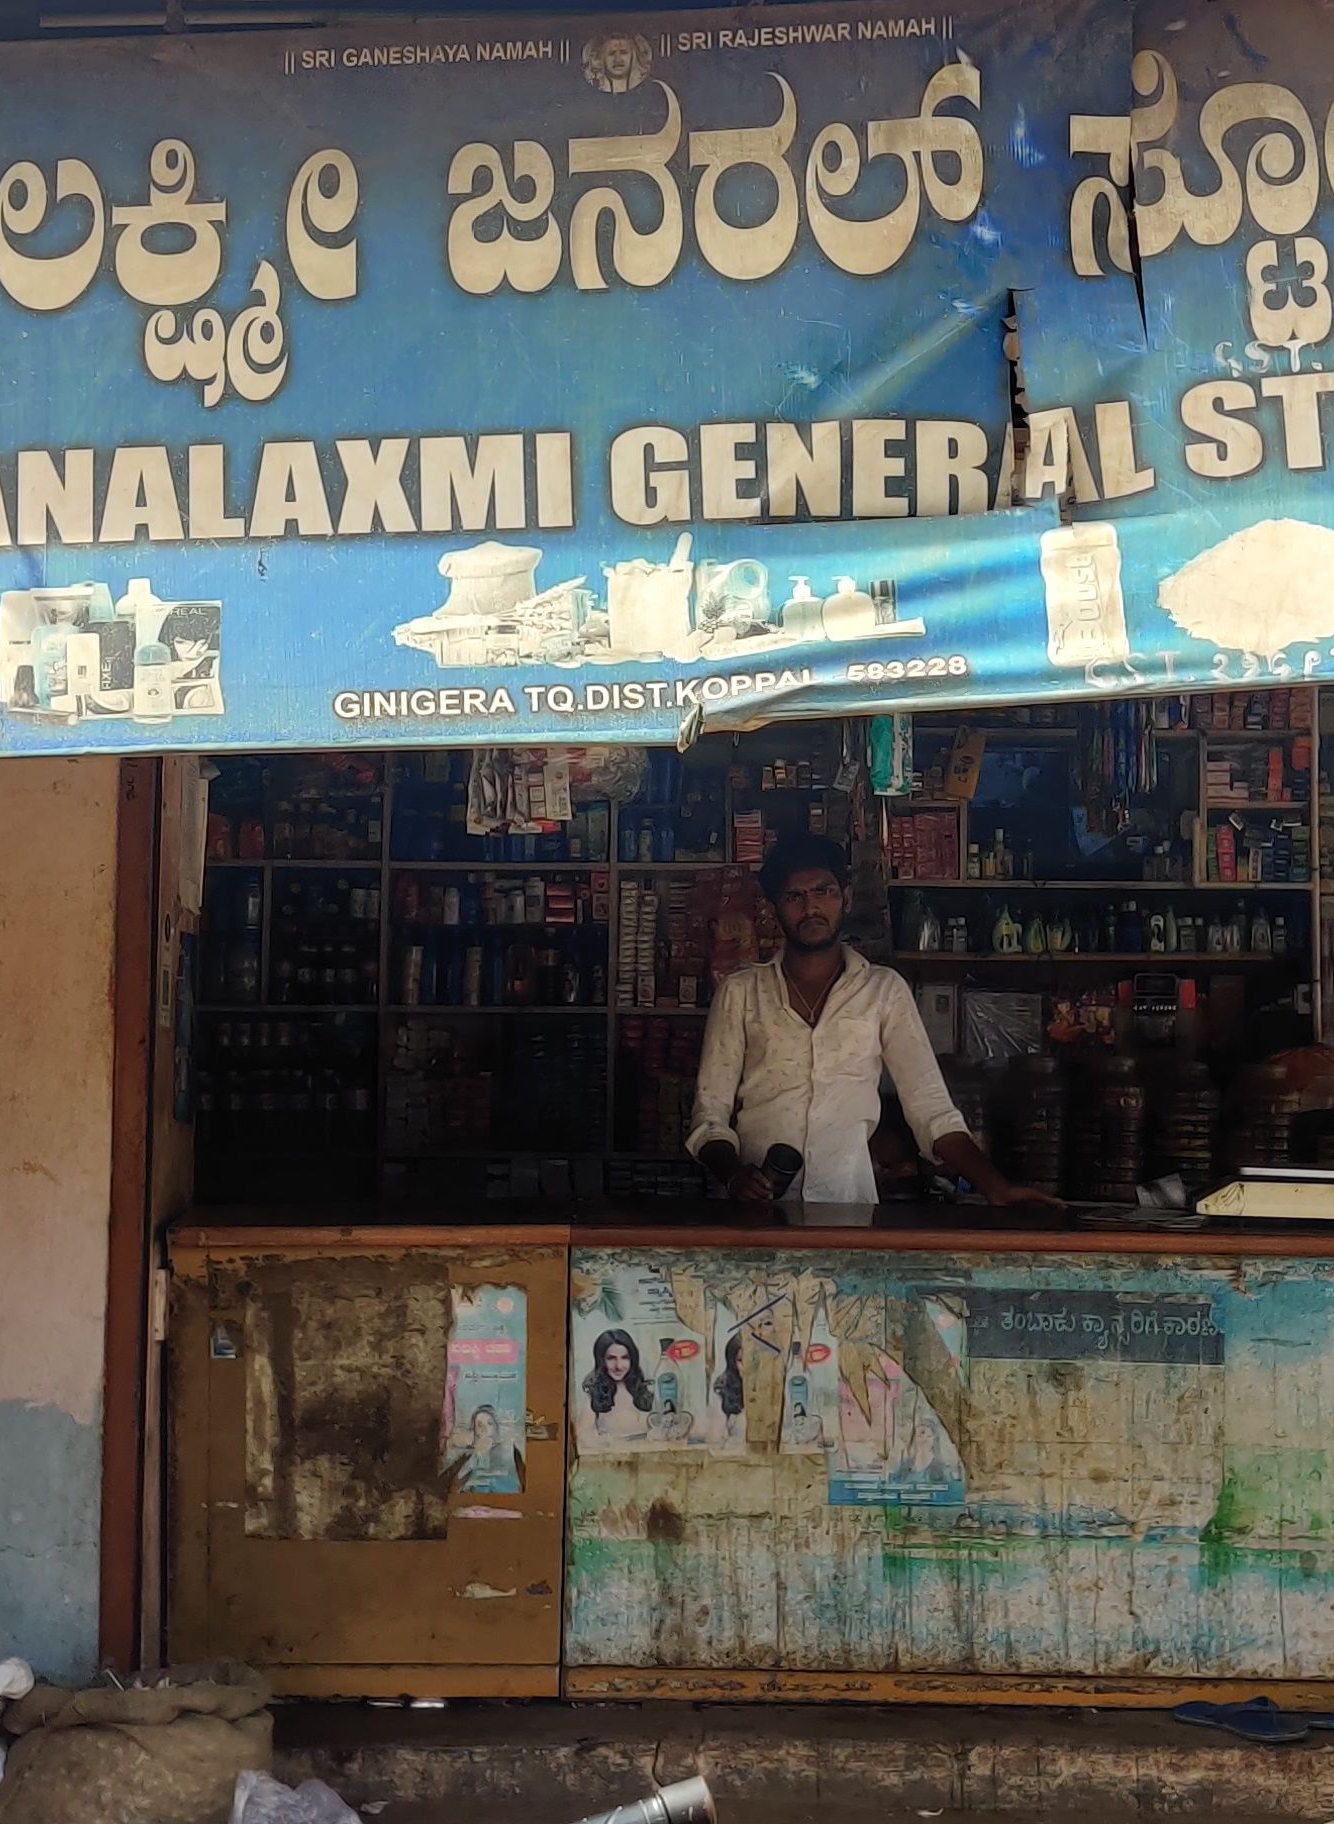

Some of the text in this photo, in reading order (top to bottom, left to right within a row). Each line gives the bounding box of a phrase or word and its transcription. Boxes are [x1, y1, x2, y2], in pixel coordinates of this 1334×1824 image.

[677, 30, 713, 53] SRI
[718, 22, 852, 50] RAJESHWAR
[857, 16, 936, 40] NAMAH
[301, 48, 337, 69] SRI
[342, 44, 470, 67] GANESHAYA
[476, 41, 554, 63] NAMAH
[446, 48, 984, 294] ಜನರಲ್
[608, 400, 1156, 529] GENERAL
[333, 687, 516, 720] GINIGERA
